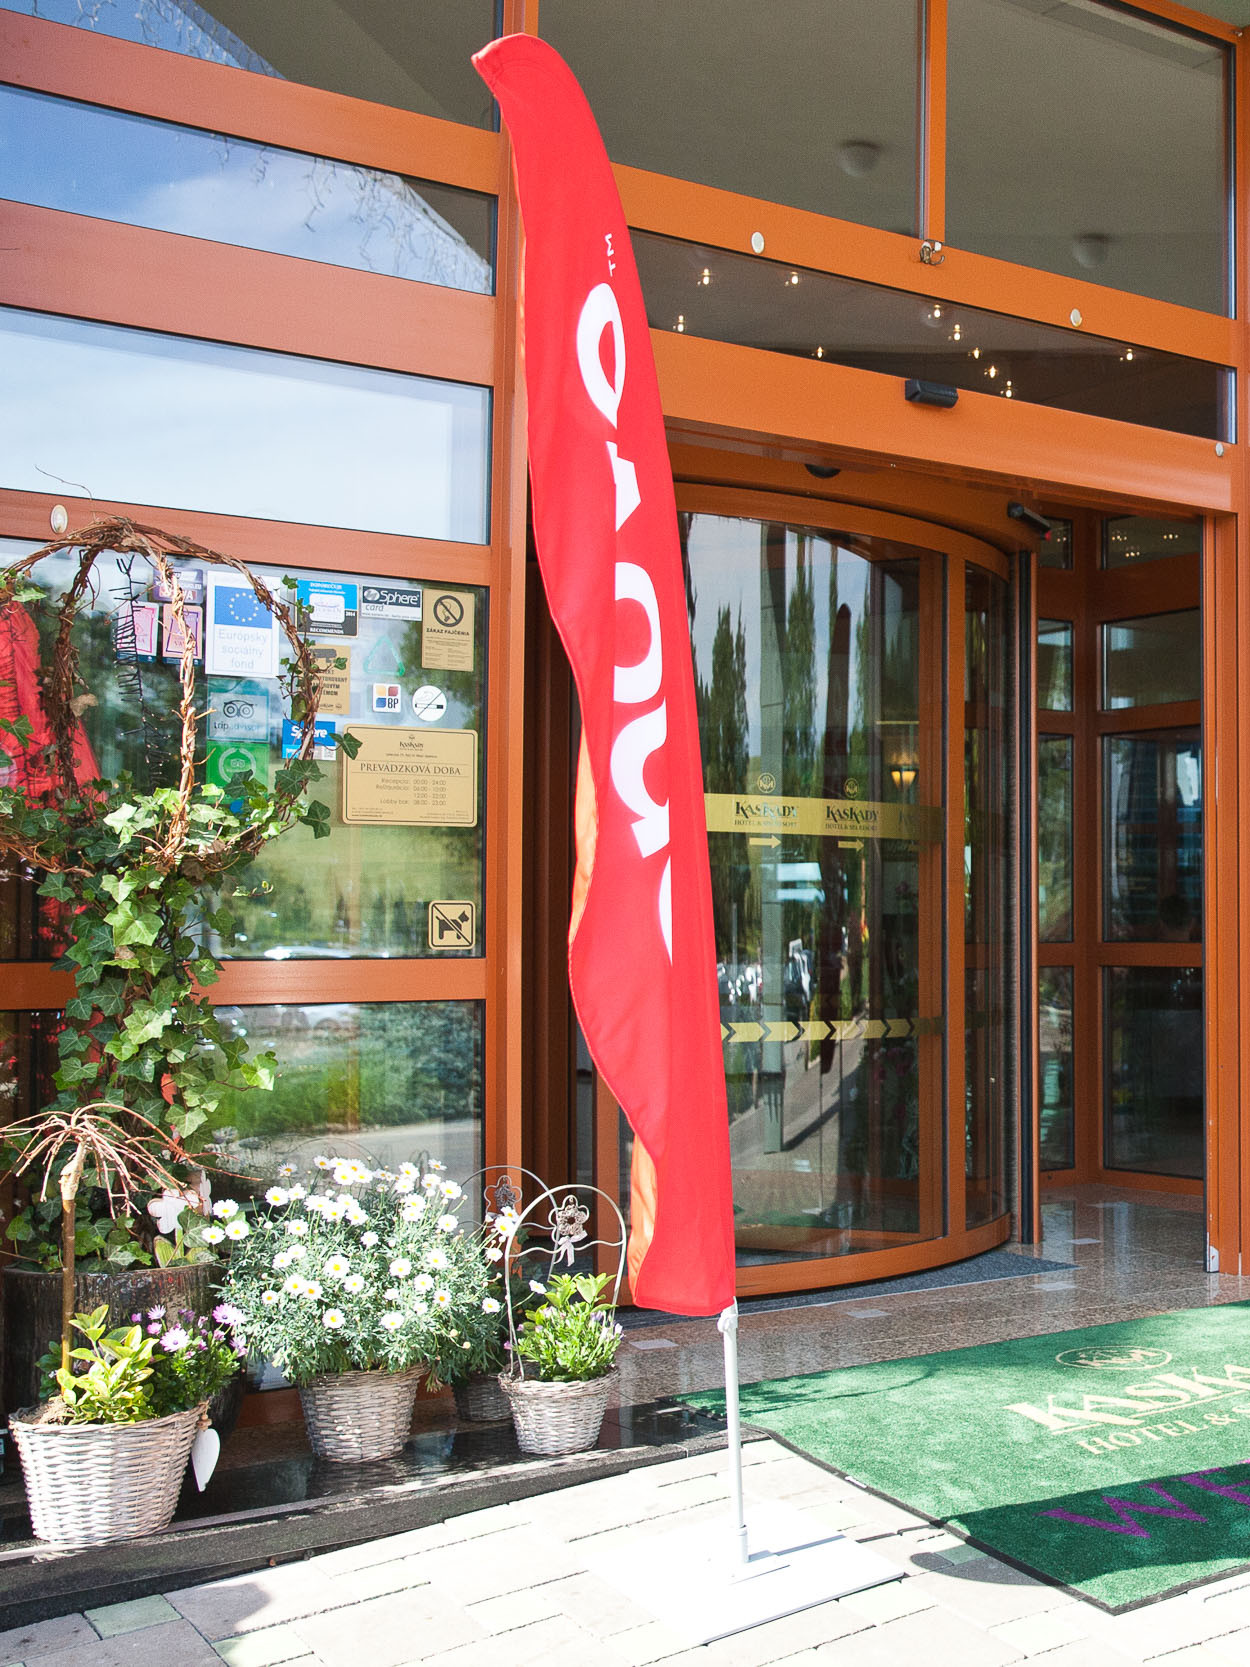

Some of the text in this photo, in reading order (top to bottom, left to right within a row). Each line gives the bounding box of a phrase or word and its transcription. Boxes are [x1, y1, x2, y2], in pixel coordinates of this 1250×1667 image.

[380, 590, 418, 605] Sphere
[365, 603, 384, 612] card
[218, 628, 267, 643] Európsky
[222, 644, 263, 657] sociálny
[231, 658, 254, 669] fond
[387, 697, 399, 709] BP
[433, 766, 461, 775] DOBA
[736, 800, 798, 819] KASKADY
[826, 805, 878, 824] KASKADY
[1076, 1420, 1208, 1455] HOTEL
[1206, 1411, 1238, 1426] &
